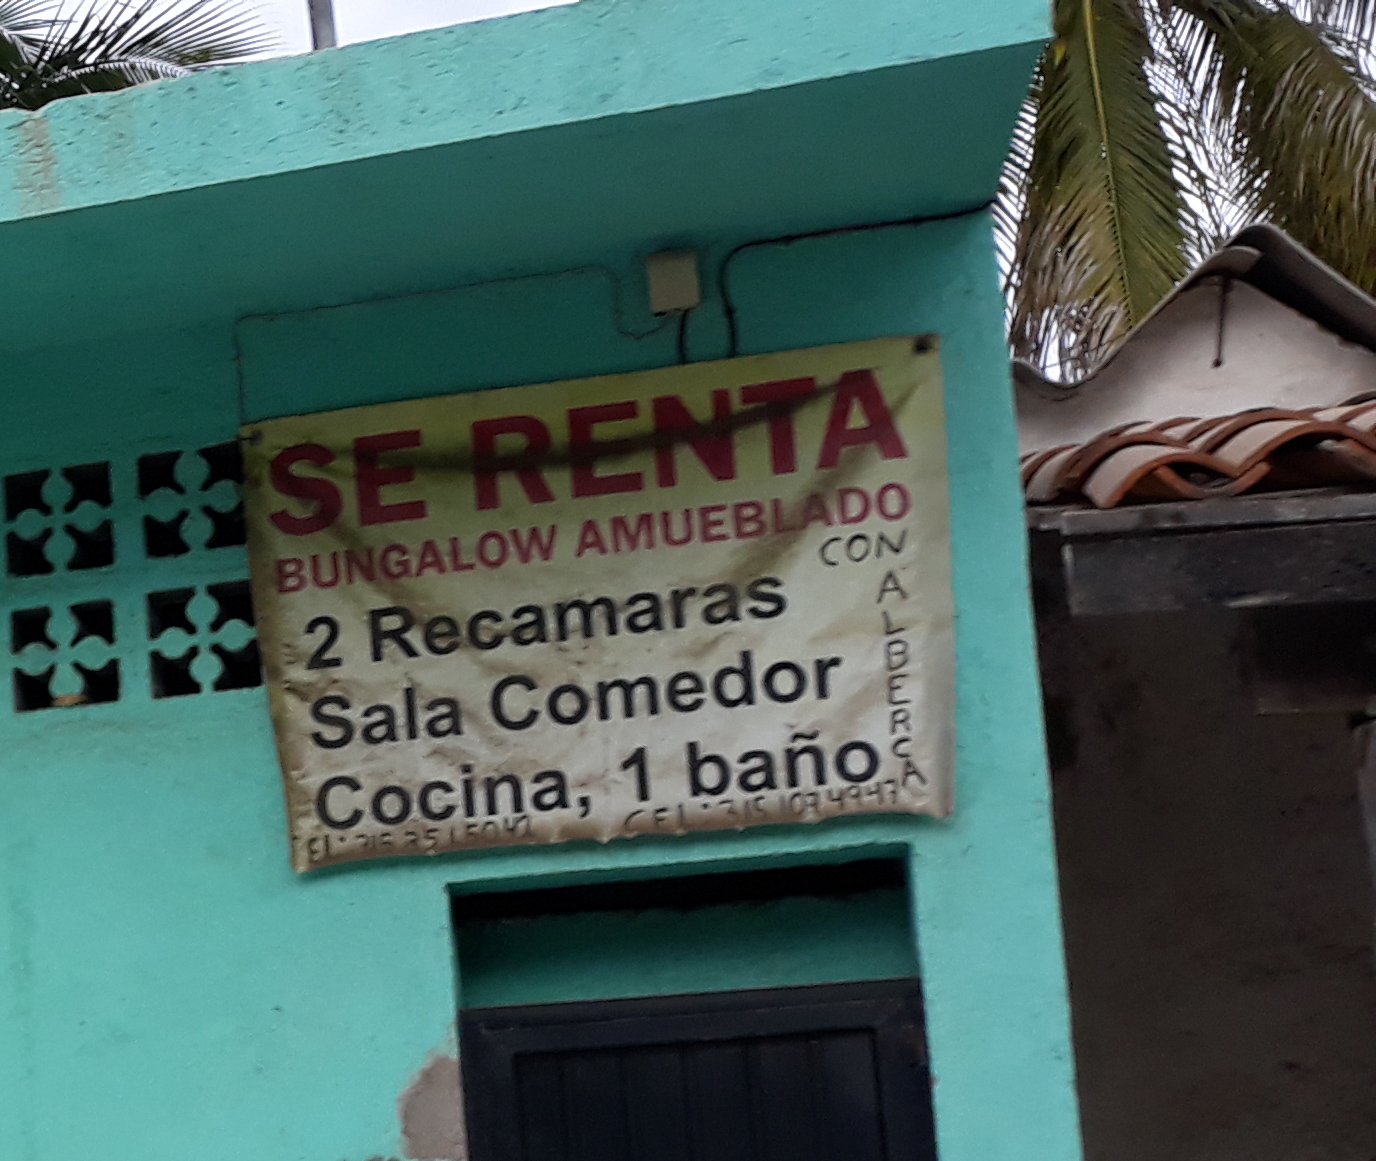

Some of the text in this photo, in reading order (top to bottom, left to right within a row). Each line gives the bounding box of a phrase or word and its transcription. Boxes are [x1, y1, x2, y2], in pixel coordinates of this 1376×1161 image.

[268, 369, 909, 536] SE RENTA
[275, 482, 912, 594] BUNGALOW AMUEBLADO
[819, 529, 907, 567] CON
[305, 575, 789, 670] 2 Recamaras
[310, 650, 842, 750] Sala Comedor
[315, 730, 879, 832] Cocina, 1 baño
